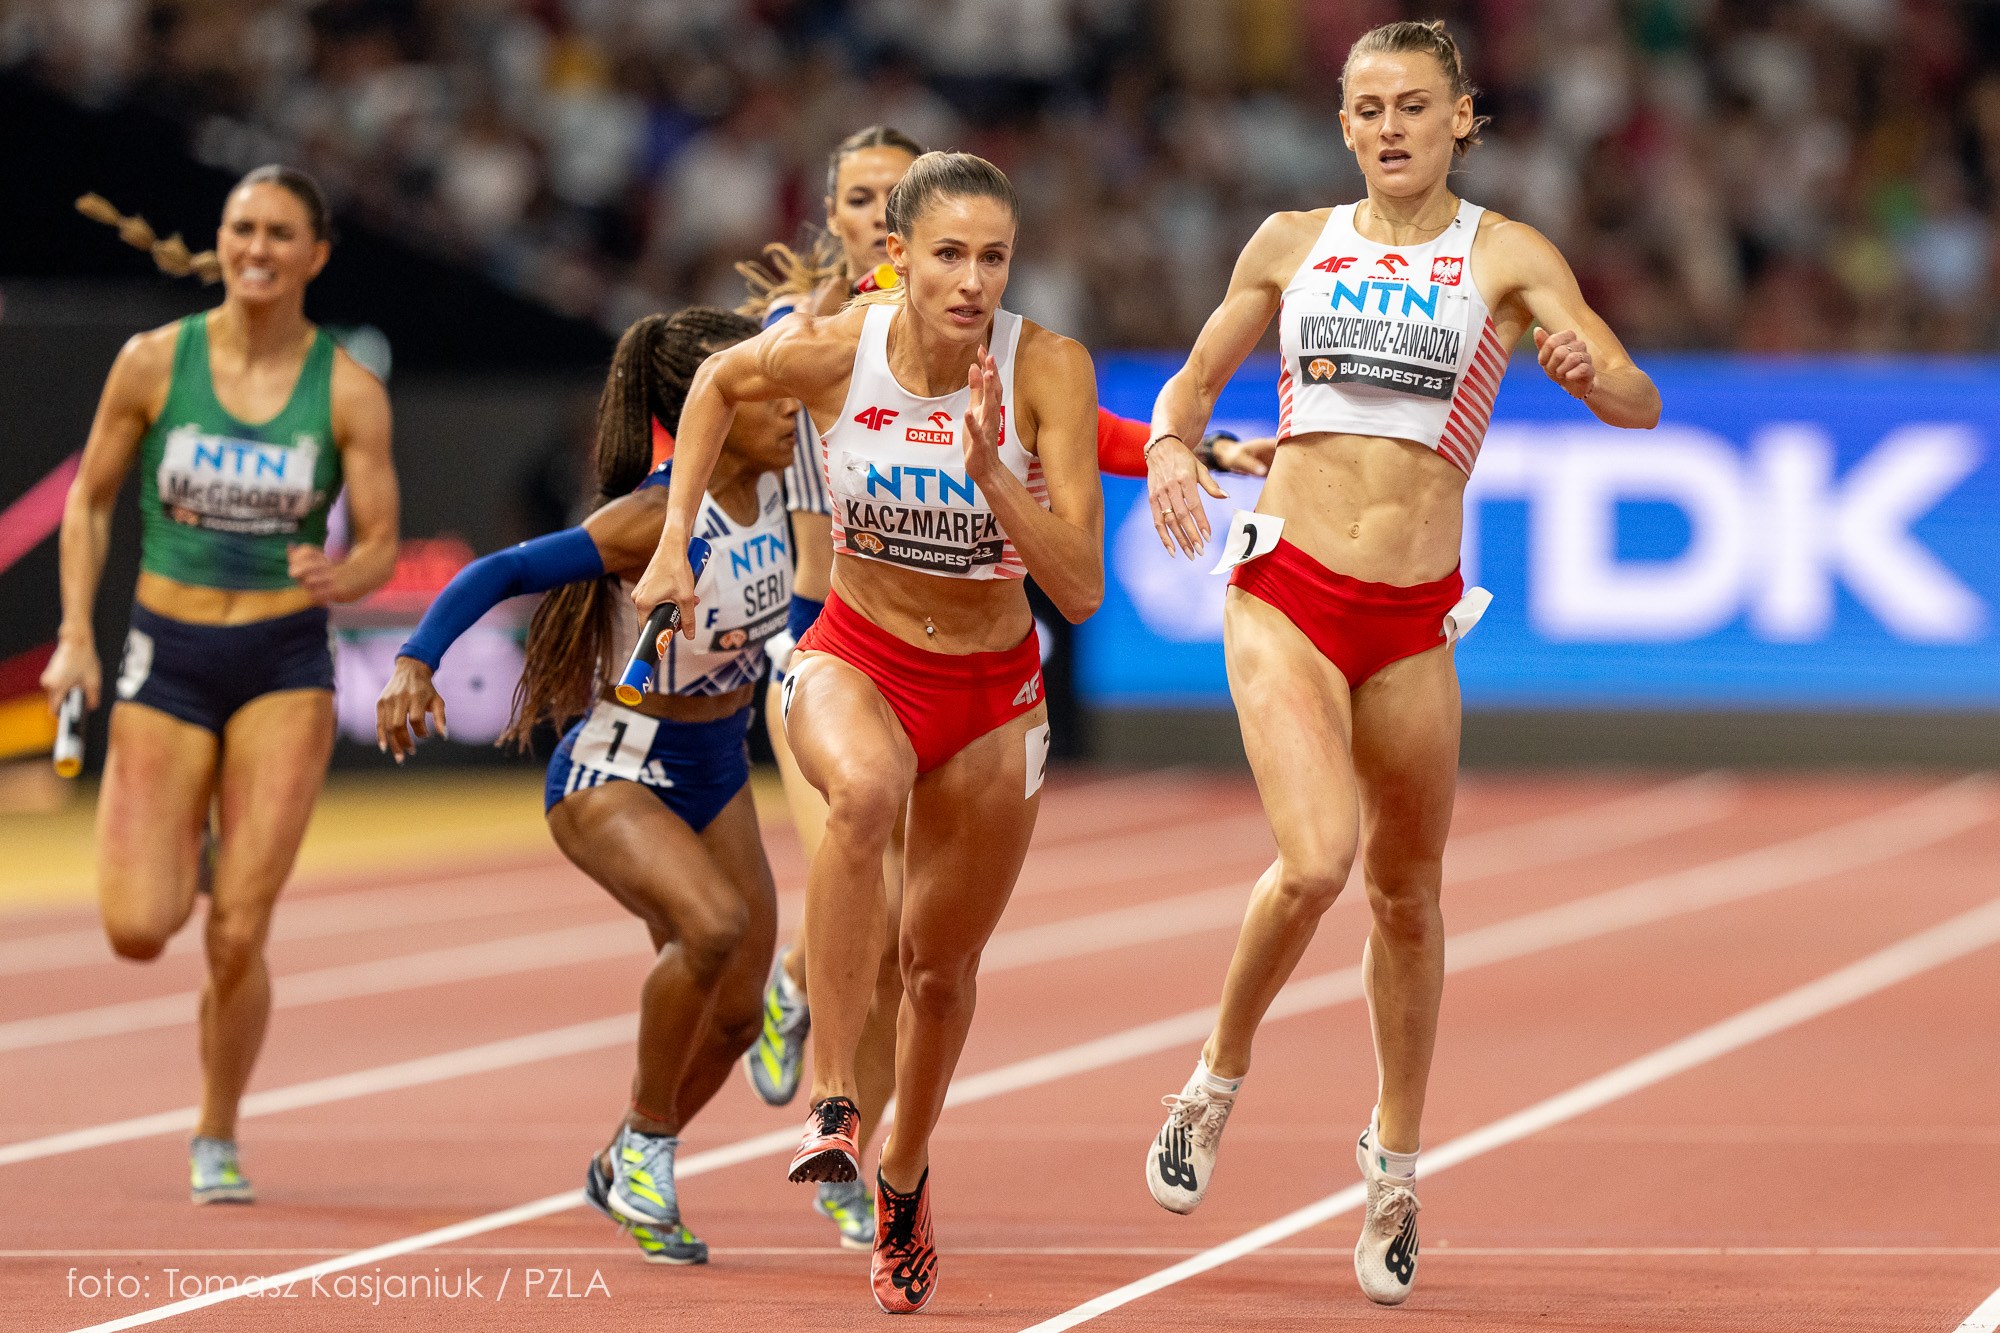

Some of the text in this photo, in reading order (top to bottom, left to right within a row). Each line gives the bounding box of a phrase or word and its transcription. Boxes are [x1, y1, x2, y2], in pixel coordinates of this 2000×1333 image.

[1313, 256, 1358, 273] 4F
[1331, 280, 1439, 320] NTN
[1301, 315, 1460, 365] WYCISZKIEWICZ-ZAWADZKA
[1340, 362, 1443, 390] BUDAPEST 23
[854, 406, 899, 431] 4F
[908, 430, 951, 444] ORLEN
[192, 439, 287, 479] NTN
[866, 463, 975, 507] NTN
[845, 498, 999, 544] KACZMAREK
[729, 525, 786, 580] NTN
[888, 544, 973, 567] BUDAPEST
[743, 570, 785, 617] SERI
[1012, 669, 1040, 706] 4F
[606, 720, 628, 762] 1
